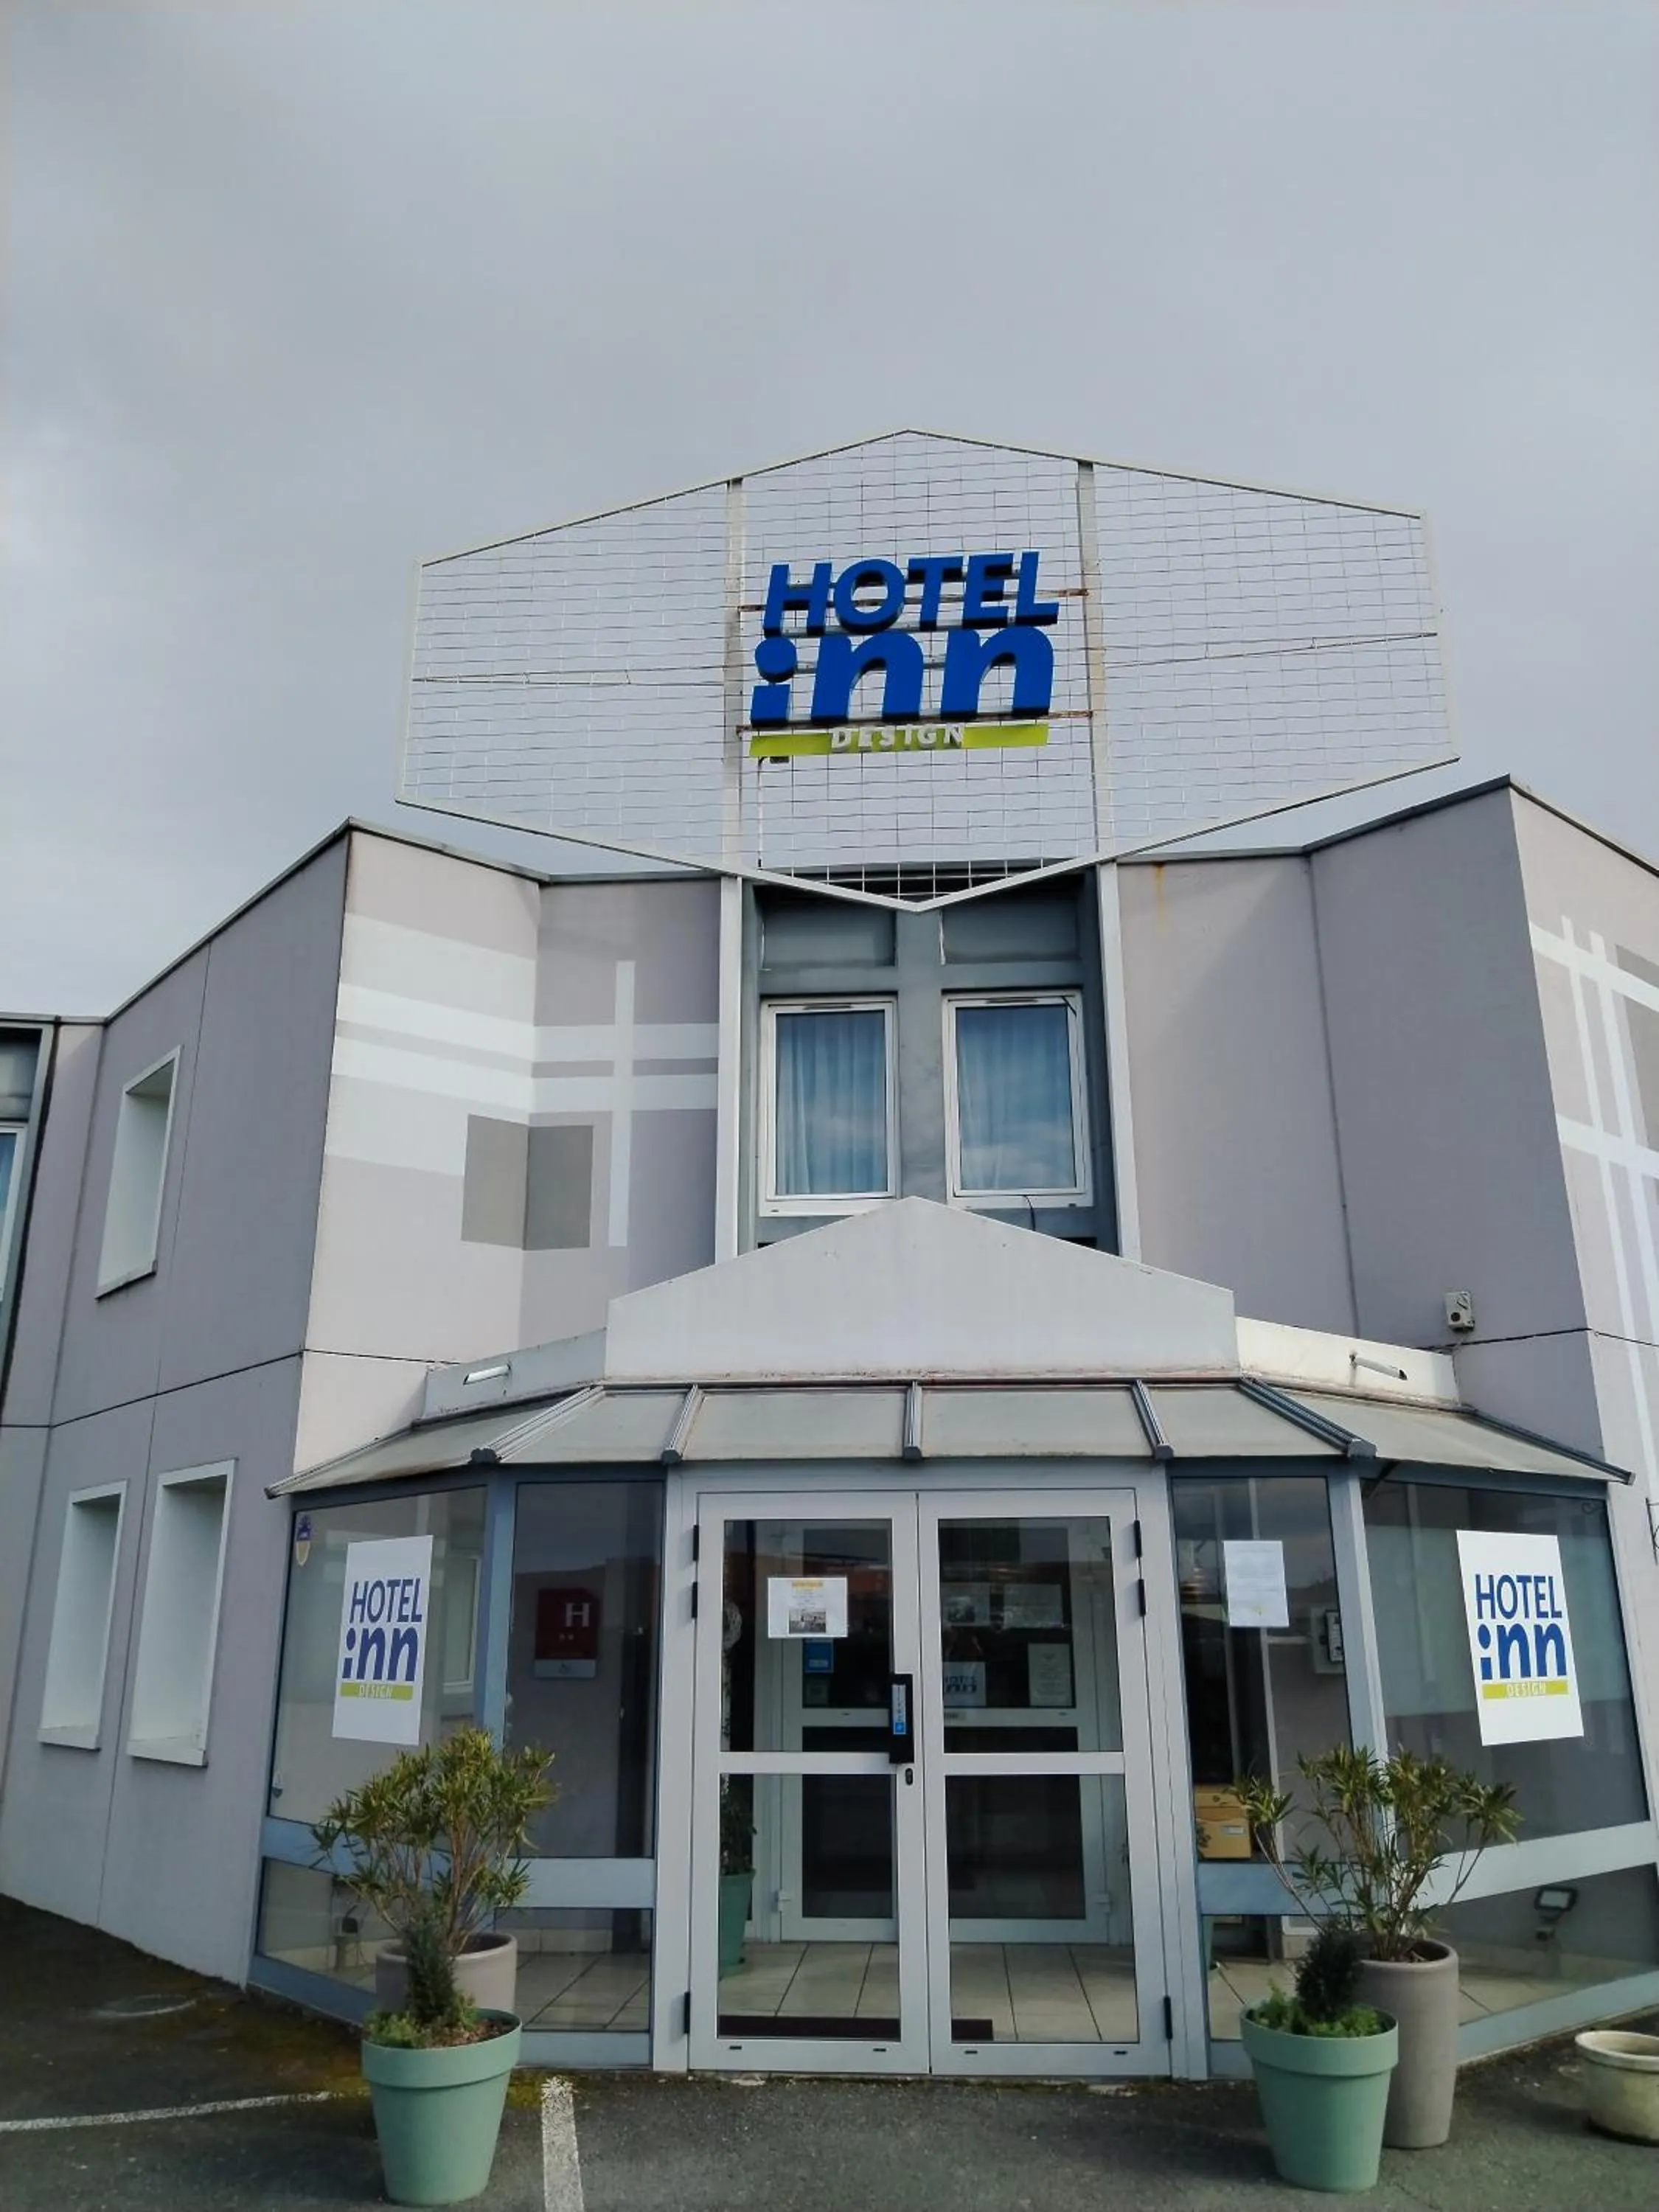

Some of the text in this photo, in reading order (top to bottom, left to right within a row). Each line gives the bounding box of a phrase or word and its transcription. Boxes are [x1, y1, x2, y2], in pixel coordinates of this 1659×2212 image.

[762, 551, 1060, 637] HOTEL
[750, 625, 1054, 727] inn
[831, 723, 964, 752] DESIGN
[349, 1577, 422, 1624] HOTEL
[565, 1601, 590, 1628] H
[1475, 1573, 1562, 1619] HOTEL
[341, 1626, 420, 1682] inn
[1478, 1623, 1567, 1680] inn
[359, 1683, 393, 1699] DESIGN
[1506, 1682, 1547, 1697] DESIGN
